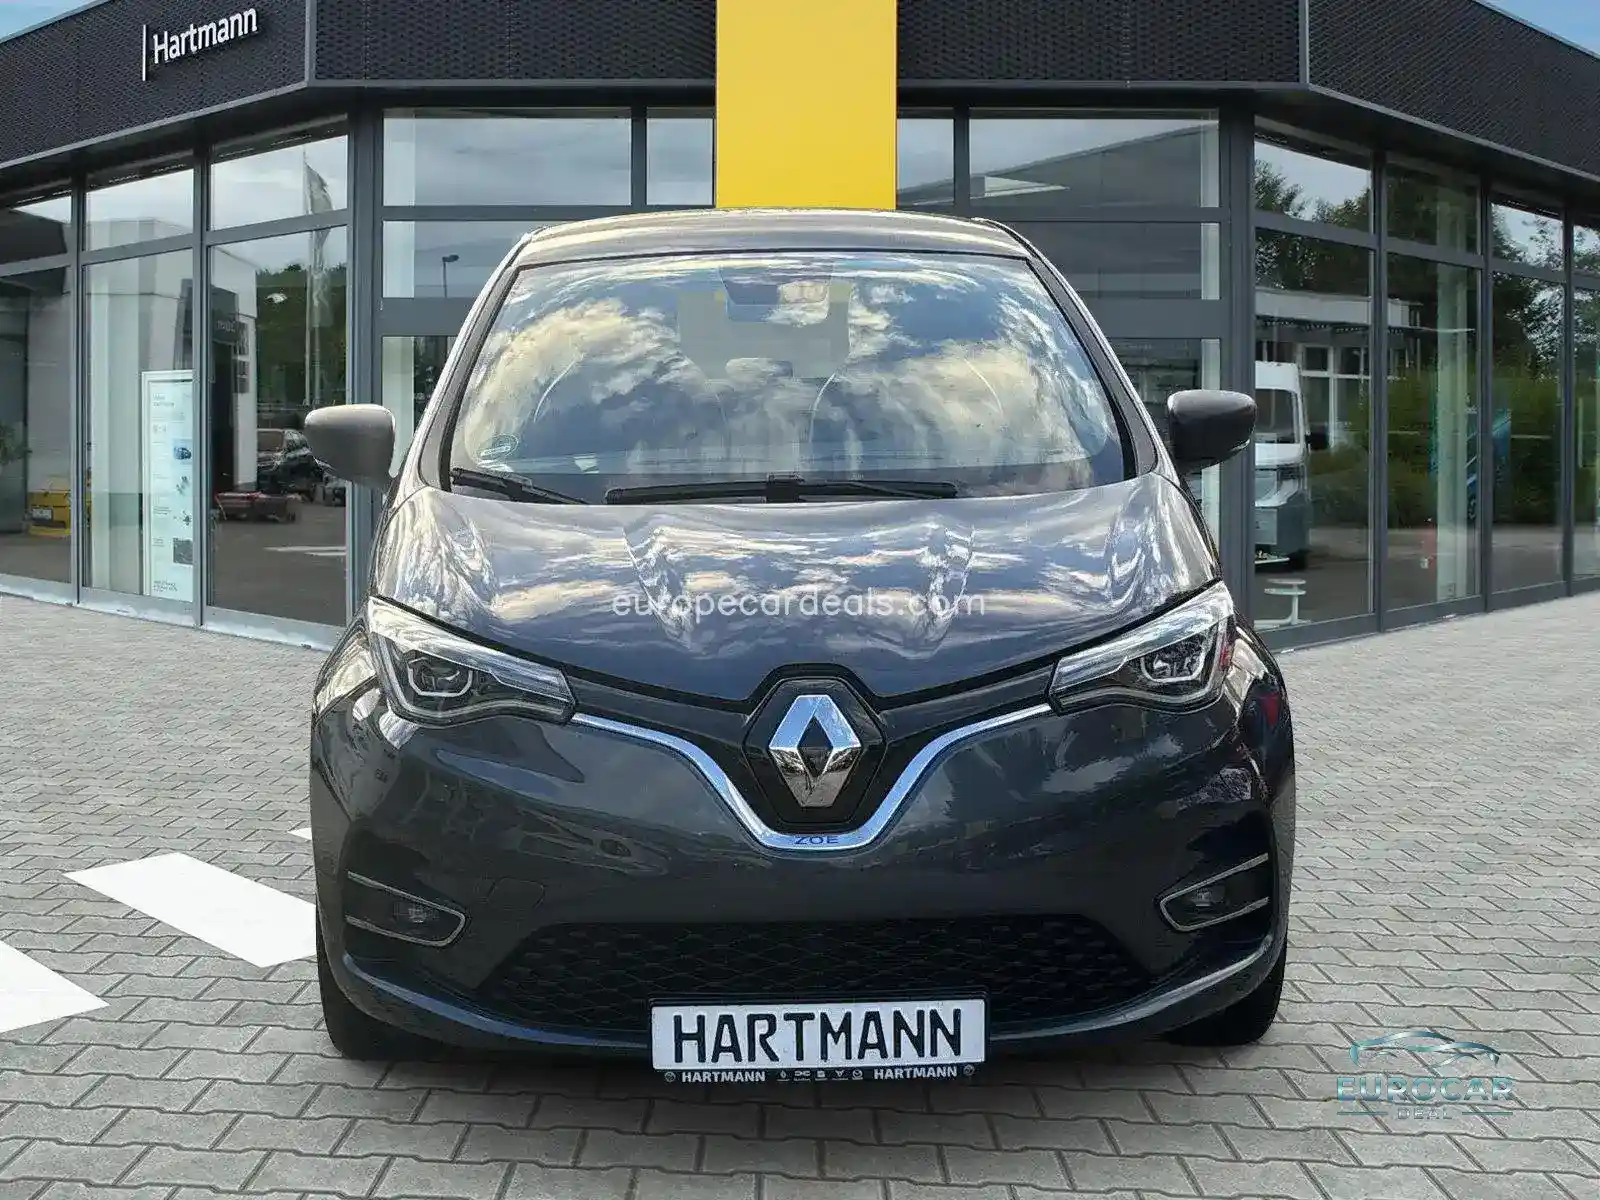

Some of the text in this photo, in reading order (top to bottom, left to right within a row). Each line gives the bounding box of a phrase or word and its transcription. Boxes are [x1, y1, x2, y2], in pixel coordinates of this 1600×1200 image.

[153, 8, 258, 64] Hartmann
[794, 835, 839, 845] ZOE
[673, 1007, 962, 1063] HARTMANN
[681, 1070, 766, 1083] HARTMANN
[873, 1065, 958, 1081] HARTMANN
